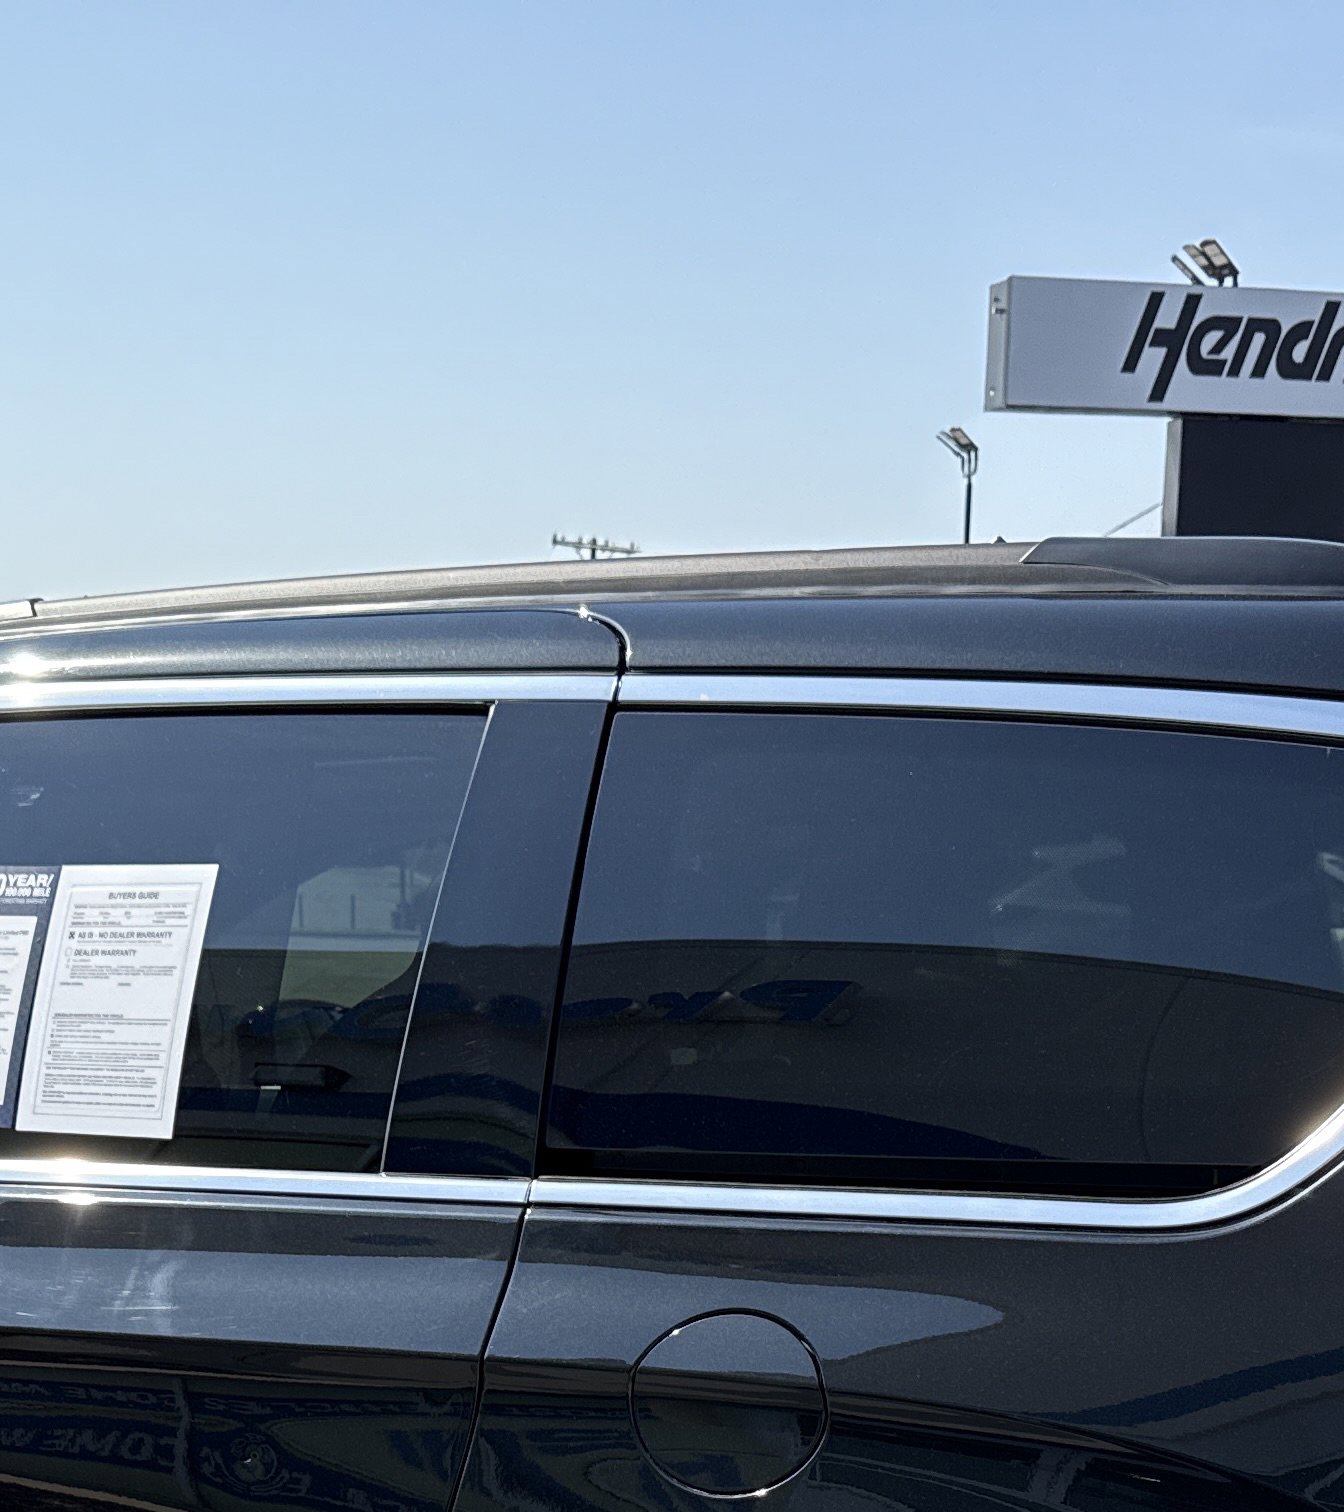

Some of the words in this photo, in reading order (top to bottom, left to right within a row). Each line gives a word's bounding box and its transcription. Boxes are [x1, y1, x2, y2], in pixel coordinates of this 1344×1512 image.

[108, 892, 137, 900] BUYERS
[138, 892, 160, 900] GUIDE
[99, 931, 108, 939] NO
[109, 931, 135, 939] DEALER
[136, 931, 173, 939] WARRANTY
[74, 949, 100, 957] DEALER
[101, 949, 137, 957] WARRANTY
